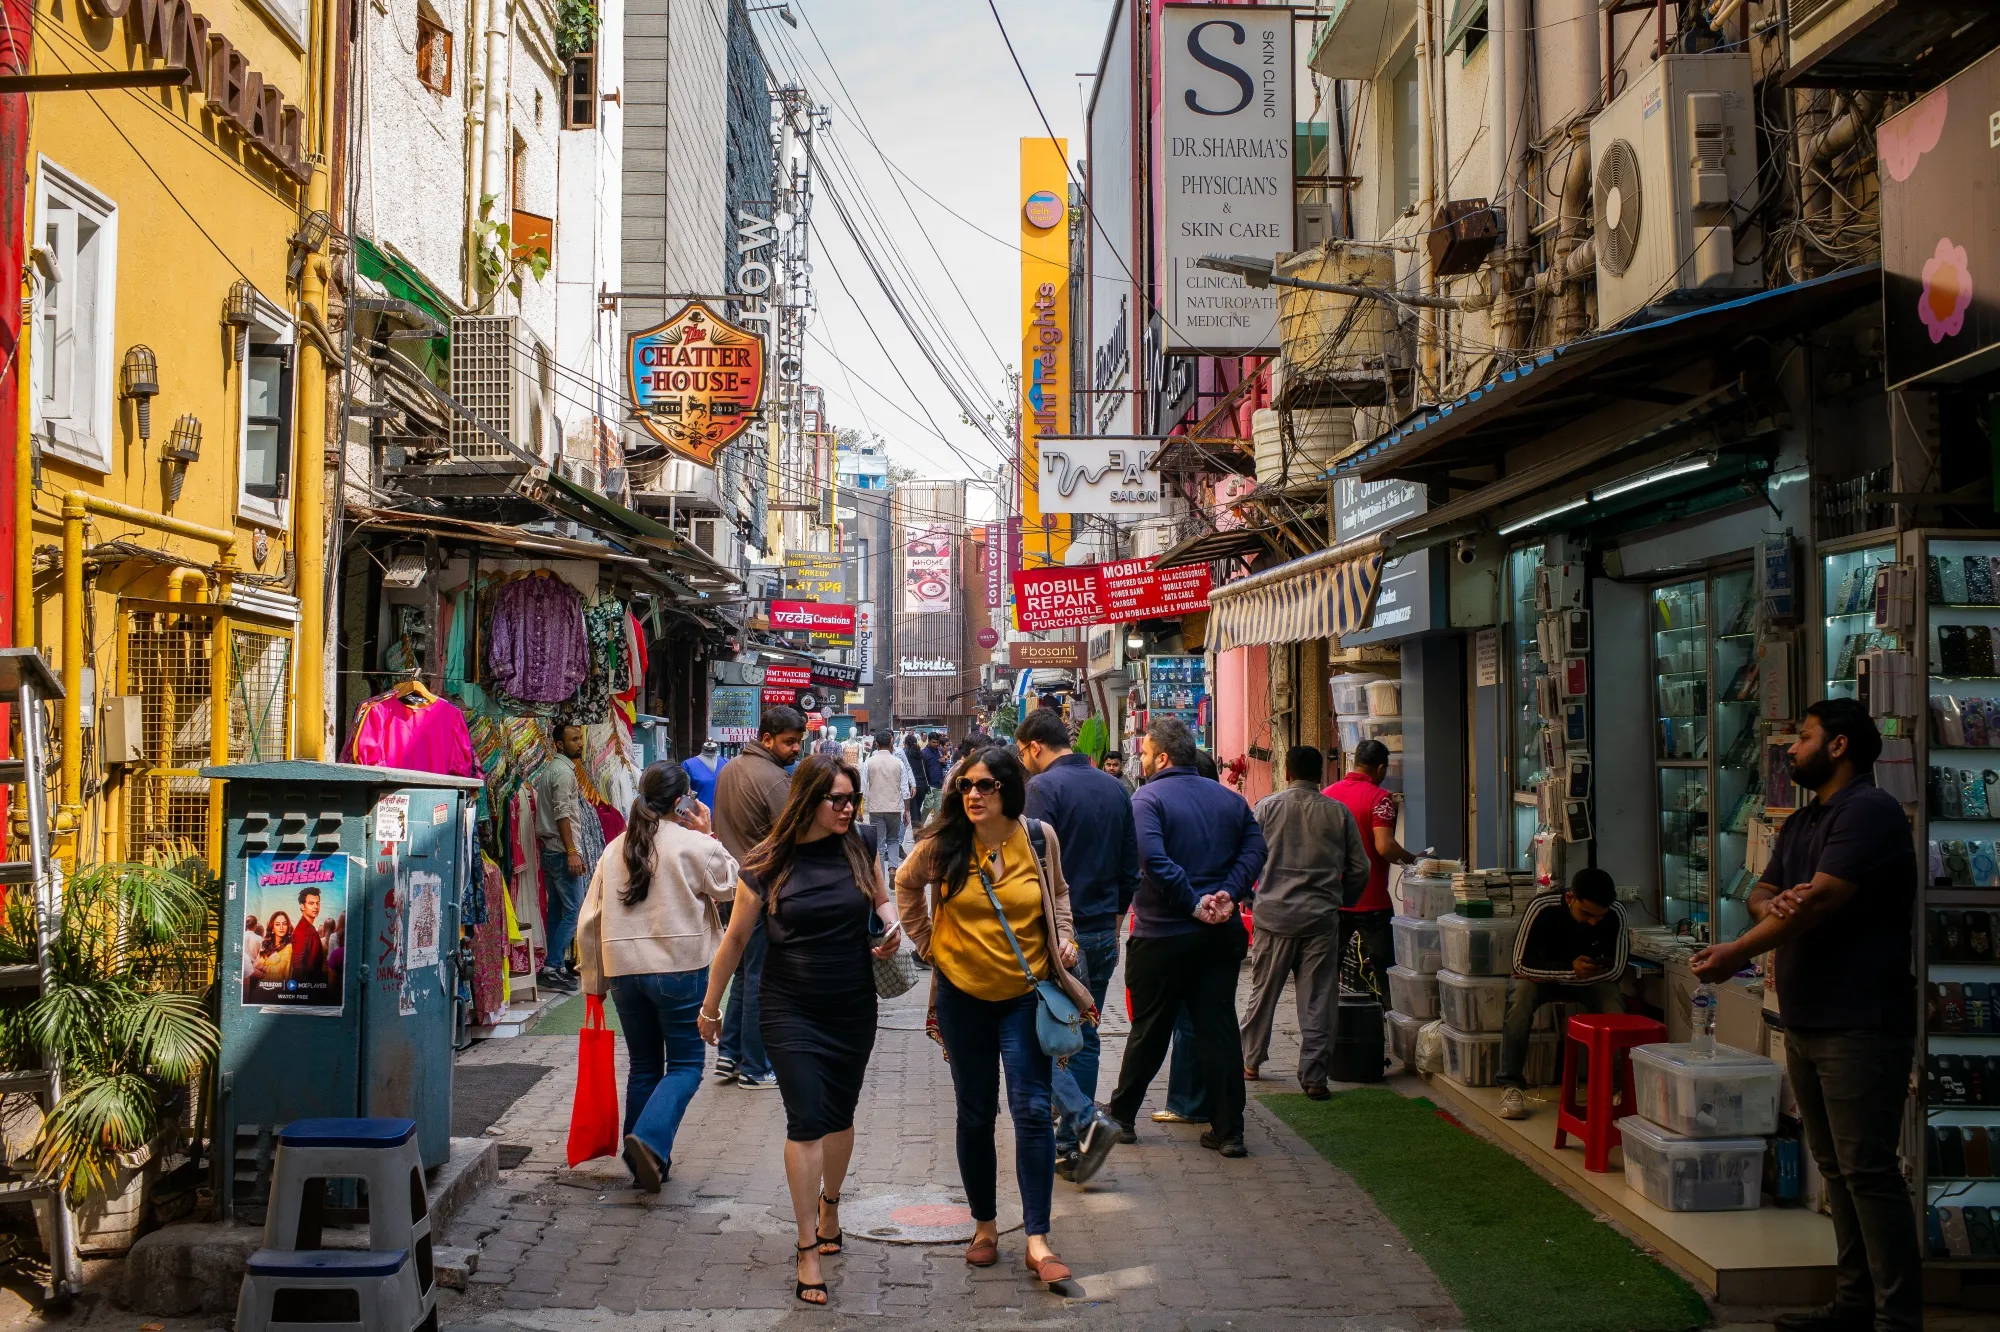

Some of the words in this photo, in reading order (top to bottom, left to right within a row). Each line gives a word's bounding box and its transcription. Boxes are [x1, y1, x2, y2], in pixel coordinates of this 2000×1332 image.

[1262, 30, 1275, 65] SKIN
[1184, 20, 1254, 116] S
[1263, 69, 1276, 118] CLINIC
[206, 33, 313, 185] HALL
[1172, 137, 1288, 159] DR.SHARMA'S
[1181, 175, 1278, 196] PHYSICIAN'S
[1222, 202, 1232, 213] &
[1181, 222, 1223, 237] SKIN
[1229, 223, 1280, 238] CARE
[1186, 277, 1246, 289] CLINICAL
[1186, 315, 1250, 327] MEDICINE
[682, 324, 707, 346] The
[1033, 282, 1062, 386] heights
[638, 346, 752, 367] CHATTER
[651, 371, 739, 392] HOUSE
[1110, 491, 1158, 502] SALON
[1400, 485, 1416, 503] Care
[988, 526, 998, 567] COFFEE
[798, 569, 830, 578] MAKEUP
[1161, 574, 1171, 582] ALL
[1172, 568, 1207, 580] ACCESSORIES
[818, 581, 842, 593] SPA
[988, 569, 998, 605] COSTA
[1024, 577, 1097, 596] MOBILE
[1109, 578, 1137, 588] TEMPERED
[1137, 576, 1154, 584] GLASS
[1162, 582, 1182, 591] MOBILE
[1182, 579, 1200, 588] COVER
[1027, 592, 1097, 611] REPAIR
[1112, 598, 1137, 608] CHARGER
[1164, 592, 1178, 601] DATA
[1178, 590, 1194, 599] CABLE
[775, 607, 814, 624] veda
[813, 614, 851, 625] Creations
[1023, 611, 1050, 621] OLD
[1053, 605, 1104, 618] MOBILE
[1110, 611, 1124, 620] OLD
[1125, 607, 1150, 618] MOBILE
[1151, 604, 1169, 613] SALE
[1020, 645, 1075, 657] #basanti
[811, 665, 856, 681] WATCH
[260, 870, 334, 887] PROFESSOR
[258, 981, 282, 989] amazon
